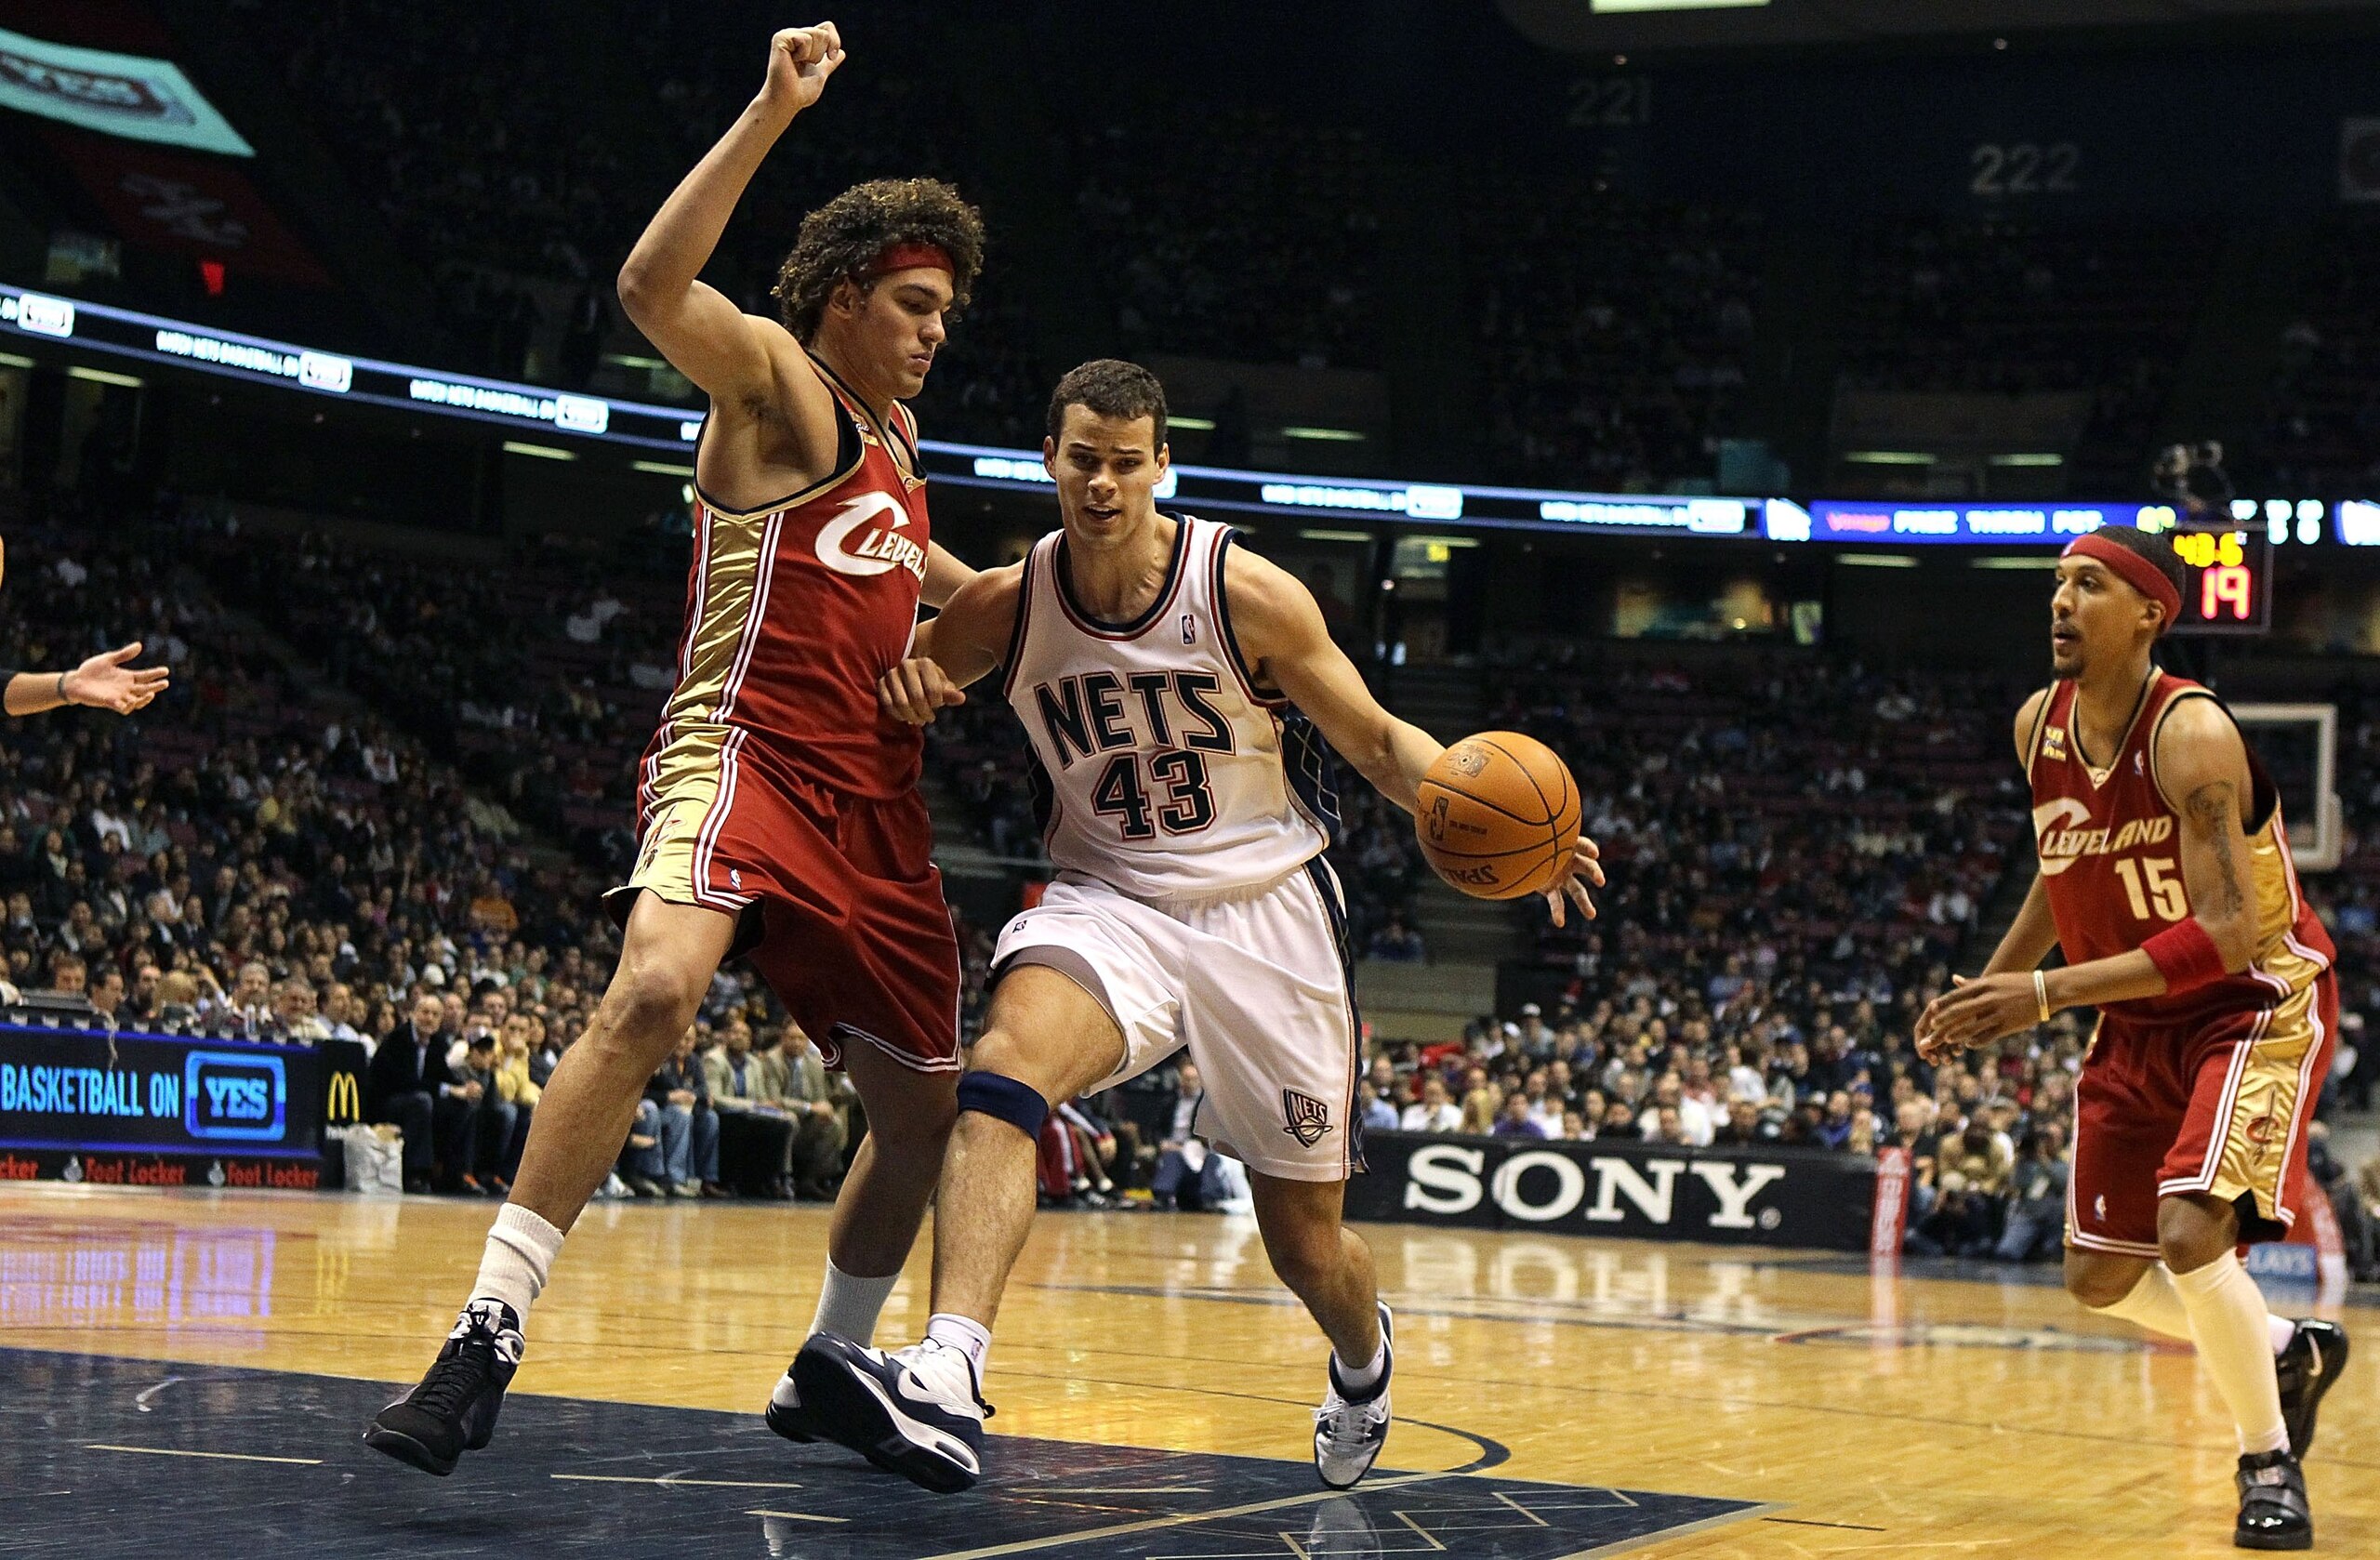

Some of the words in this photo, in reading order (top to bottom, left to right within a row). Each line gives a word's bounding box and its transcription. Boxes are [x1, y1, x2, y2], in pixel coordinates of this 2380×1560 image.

[1971, 144, 2081, 193] 222
[815, 490, 928, 582] CLEVEL
[2202, 564, 2252, 620] 19
[1034, 669, 1236, 770] NETS
[1091, 749, 1217, 840] 43
[2033, 797, 2173, 876] CLEVELAND
[2114, 857, 2188, 922] 15
[1, 1063, 144, 1117] BASKETBALL
[149, 1072, 179, 1118] ON
[205, 1077, 270, 1120] YES
[1289, 1092, 1326, 1125] NETS
[128, 1160, 185, 1185] Locker
[1404, 1144, 1786, 1229] SONY
